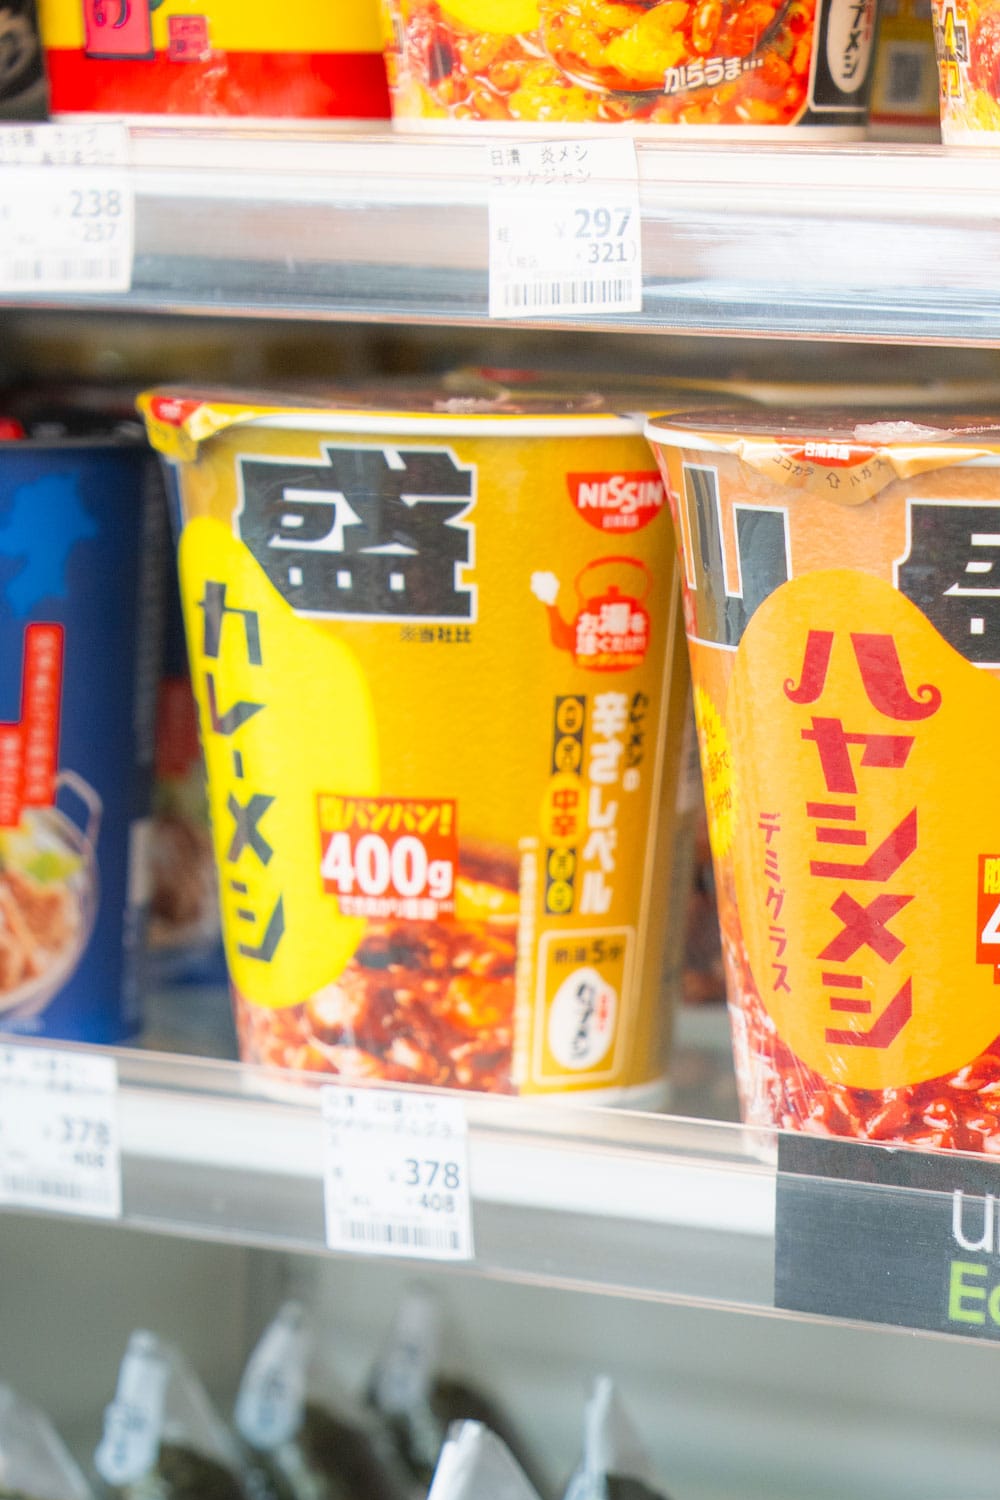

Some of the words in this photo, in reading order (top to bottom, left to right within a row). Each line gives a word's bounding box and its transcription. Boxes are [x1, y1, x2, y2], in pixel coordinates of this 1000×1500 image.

[70, 188, 122, 218] 238
[574, 206, 633, 239] 297
[588, 241, 628, 264] 321
[577, 476, 665, 514] NISSIN
[196, 580, 286, 964] カレーメシ
[551, 788, 580, 838] 中辛
[578, 690, 629, 916] 辛さレベル
[782, 629, 943, 1049] ハヤシメシ
[321, 831, 454, 899] 400g
[757, 810, 793, 995] デミグラス
[404, 1157, 460, 1190] 378
[419, 1193, 455, 1213] 408
